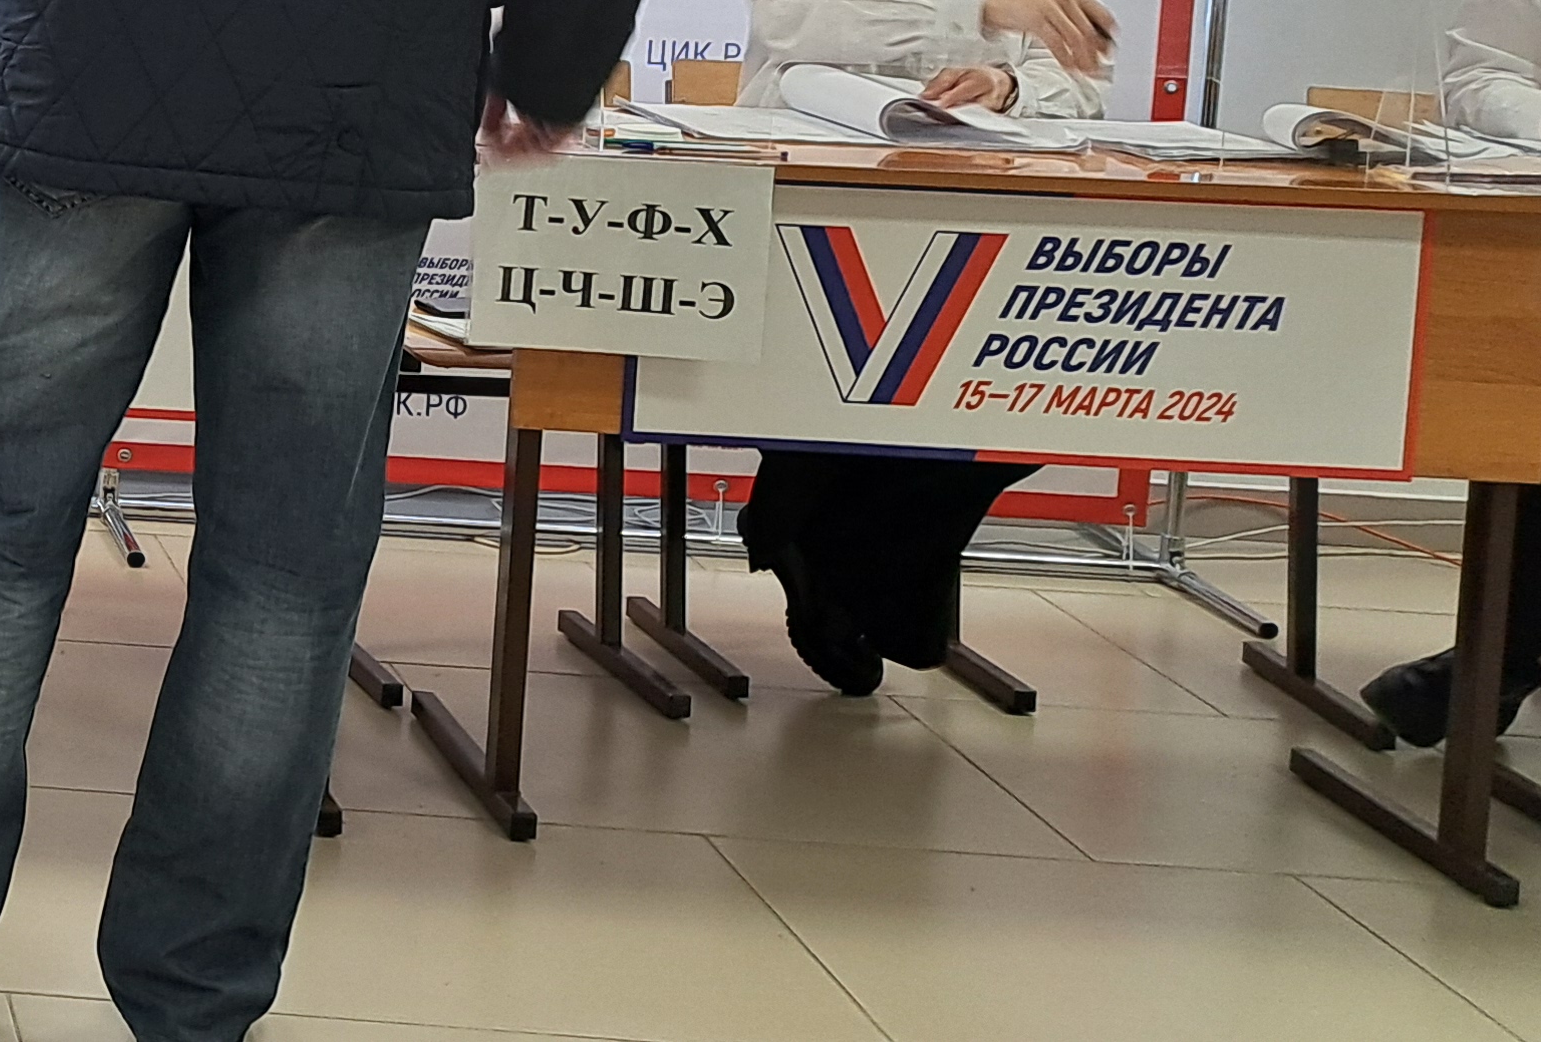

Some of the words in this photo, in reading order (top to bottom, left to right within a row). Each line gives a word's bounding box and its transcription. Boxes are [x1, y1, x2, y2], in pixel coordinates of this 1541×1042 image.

[513, 194, 735, 247] Т-У-Ф-Х
[1025, 236, 1232, 279] ВЫБОРЫ
[495, 265, 735, 320] Ц-Ч-Ш-Э
[999, 285, 1286, 333] ПРЕЗИДЕНТА
[972, 334, 1159, 375] РОССИИ
[396, 392, 468, 419] К.РФ
[1043, 384, 1157, 419] МАРТА
[1157, 390, 1238, 423] 2024
